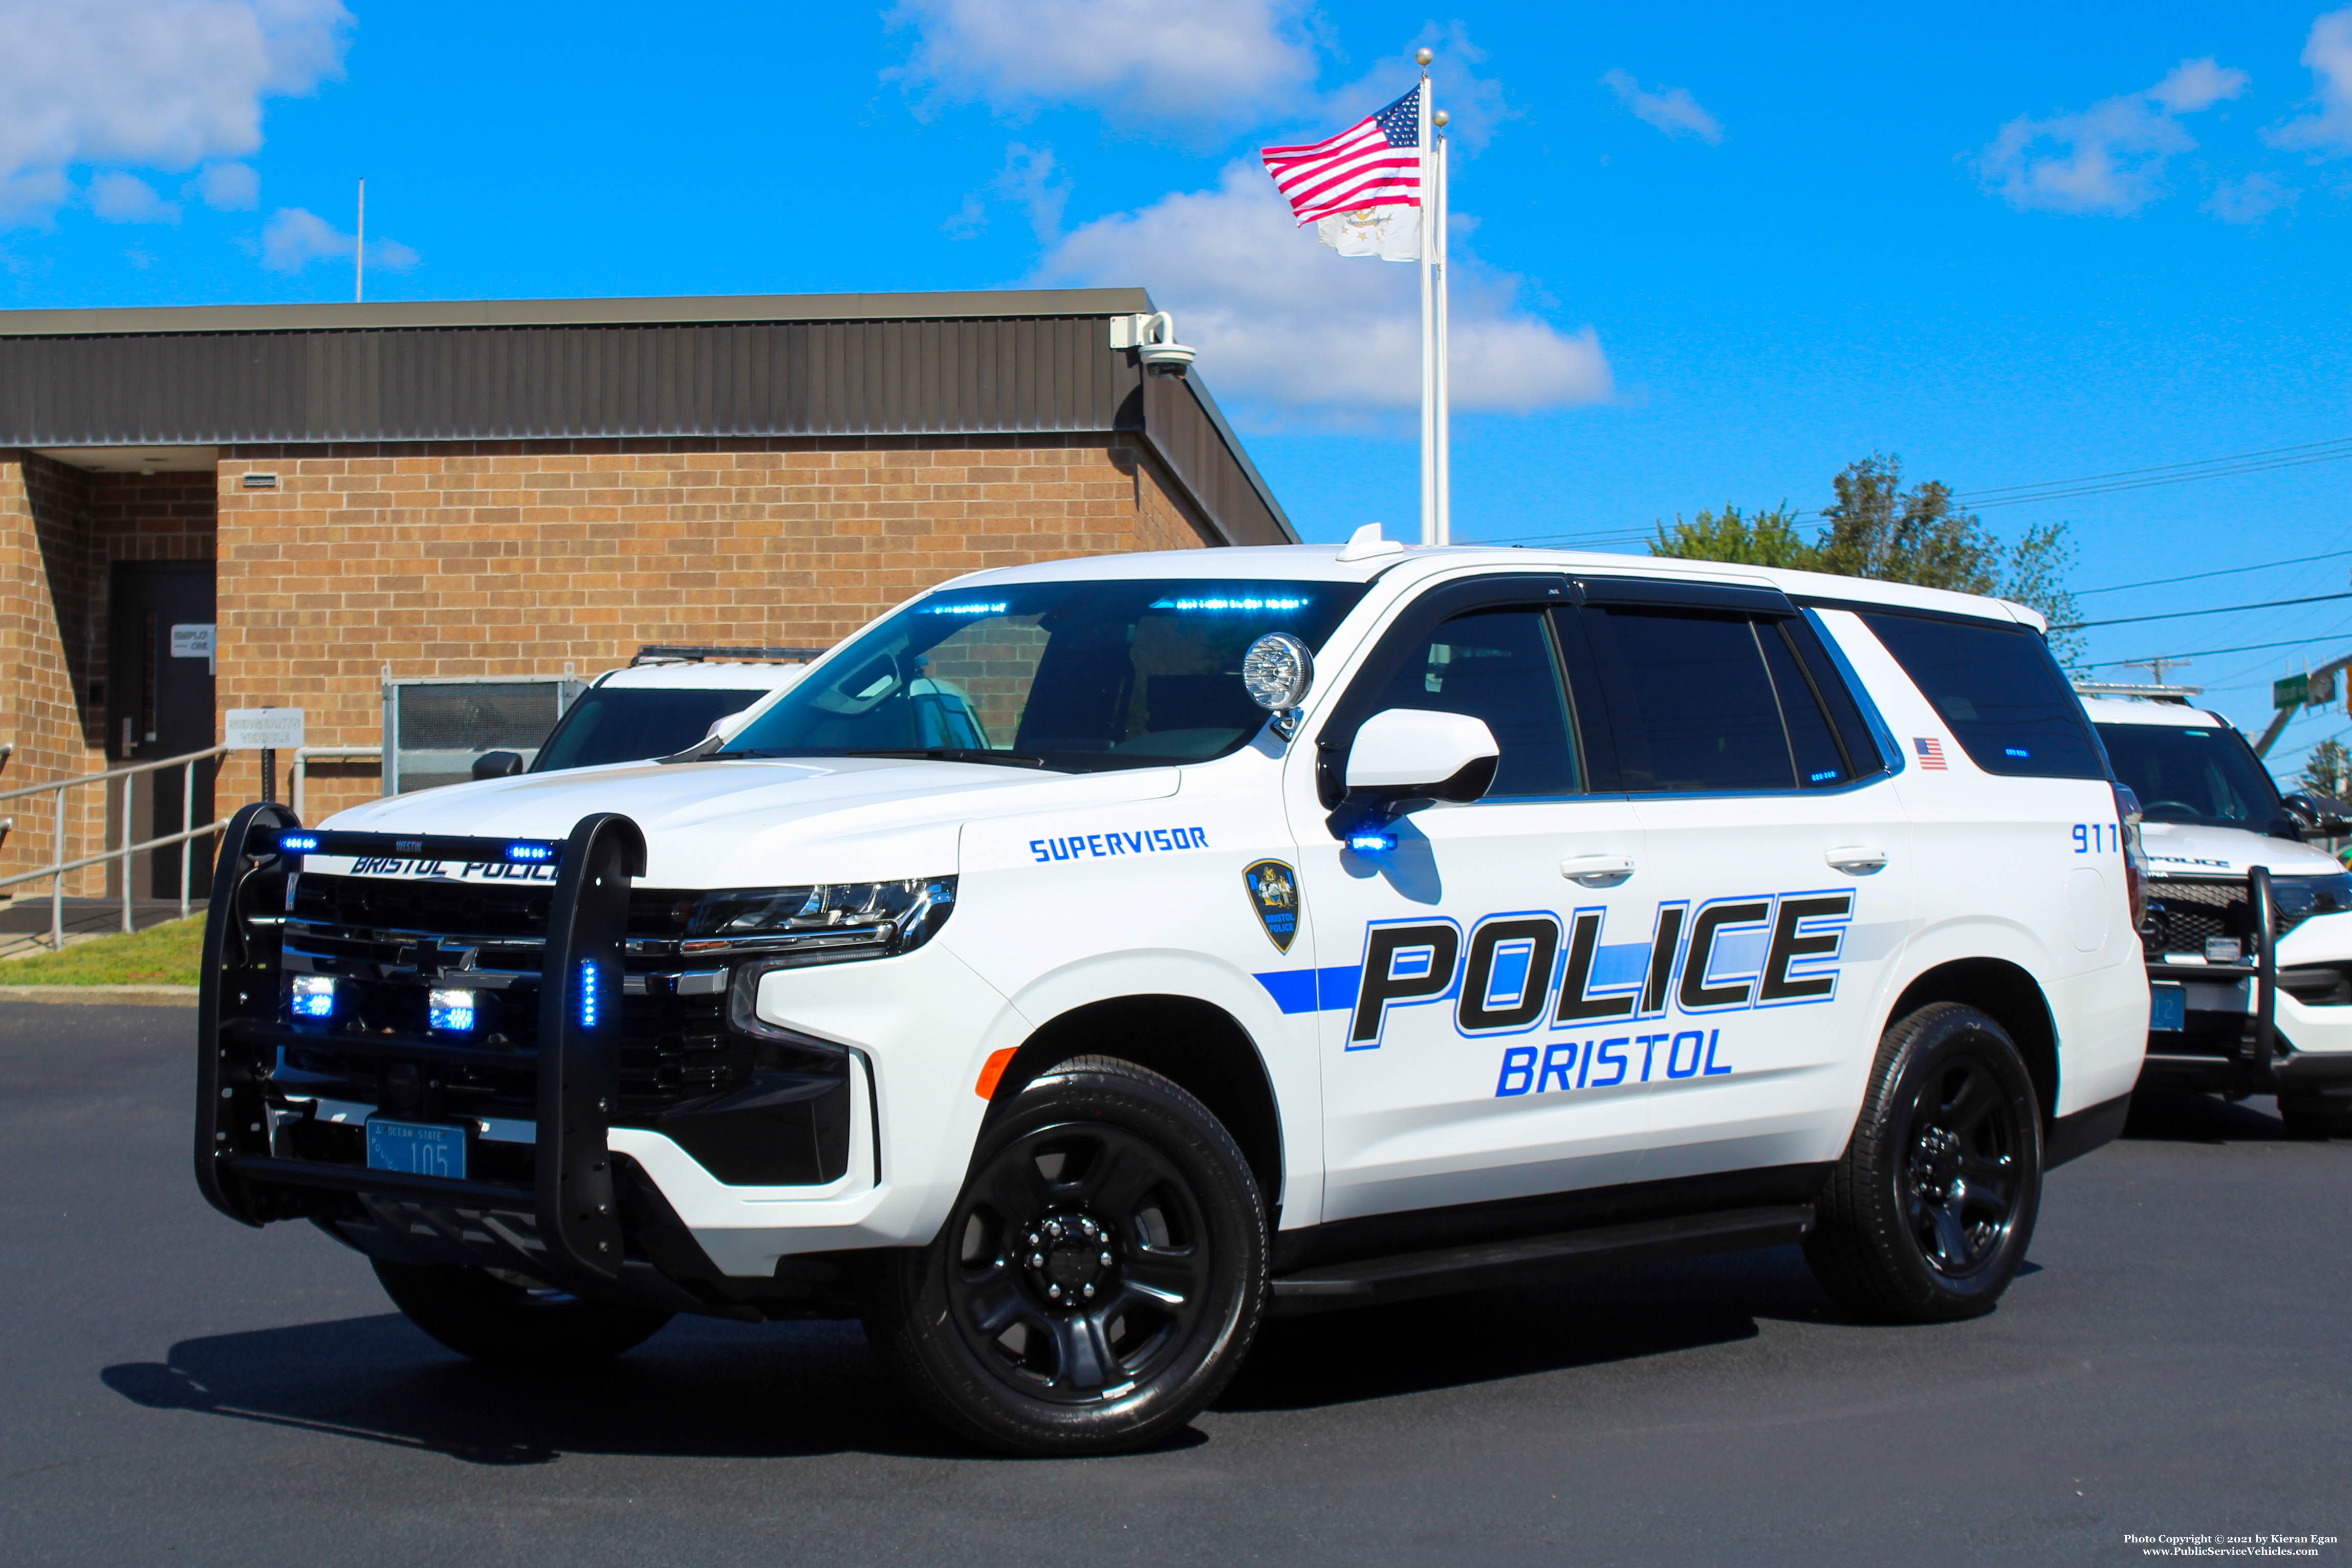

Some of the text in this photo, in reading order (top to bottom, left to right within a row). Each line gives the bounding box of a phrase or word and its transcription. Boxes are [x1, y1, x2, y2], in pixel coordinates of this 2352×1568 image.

[229, 718, 300, 730] SERGEANTS
[241, 732, 290, 743] VEHICLE
[1029, 826, 1210, 863] SUPERVISOR
[2073, 823, 2117, 853] 911
[461, 861, 559, 881] POLIC
[2148, 856, 2231, 869] POLICE
[1247, 870, 1294, 890] R I
[1265, 912, 1295, 924] BRISTOL
[1268, 923, 1295, 933] POLICE
[1344, 888, 1857, 1053] POLICE
[1494, 1028, 1733, 1099] BRISTOL
[388, 1127, 442, 1142] OCEAN STATE
[372, 1138, 398, 1171] POLIC
[411, 1142, 448, 1177] 105
